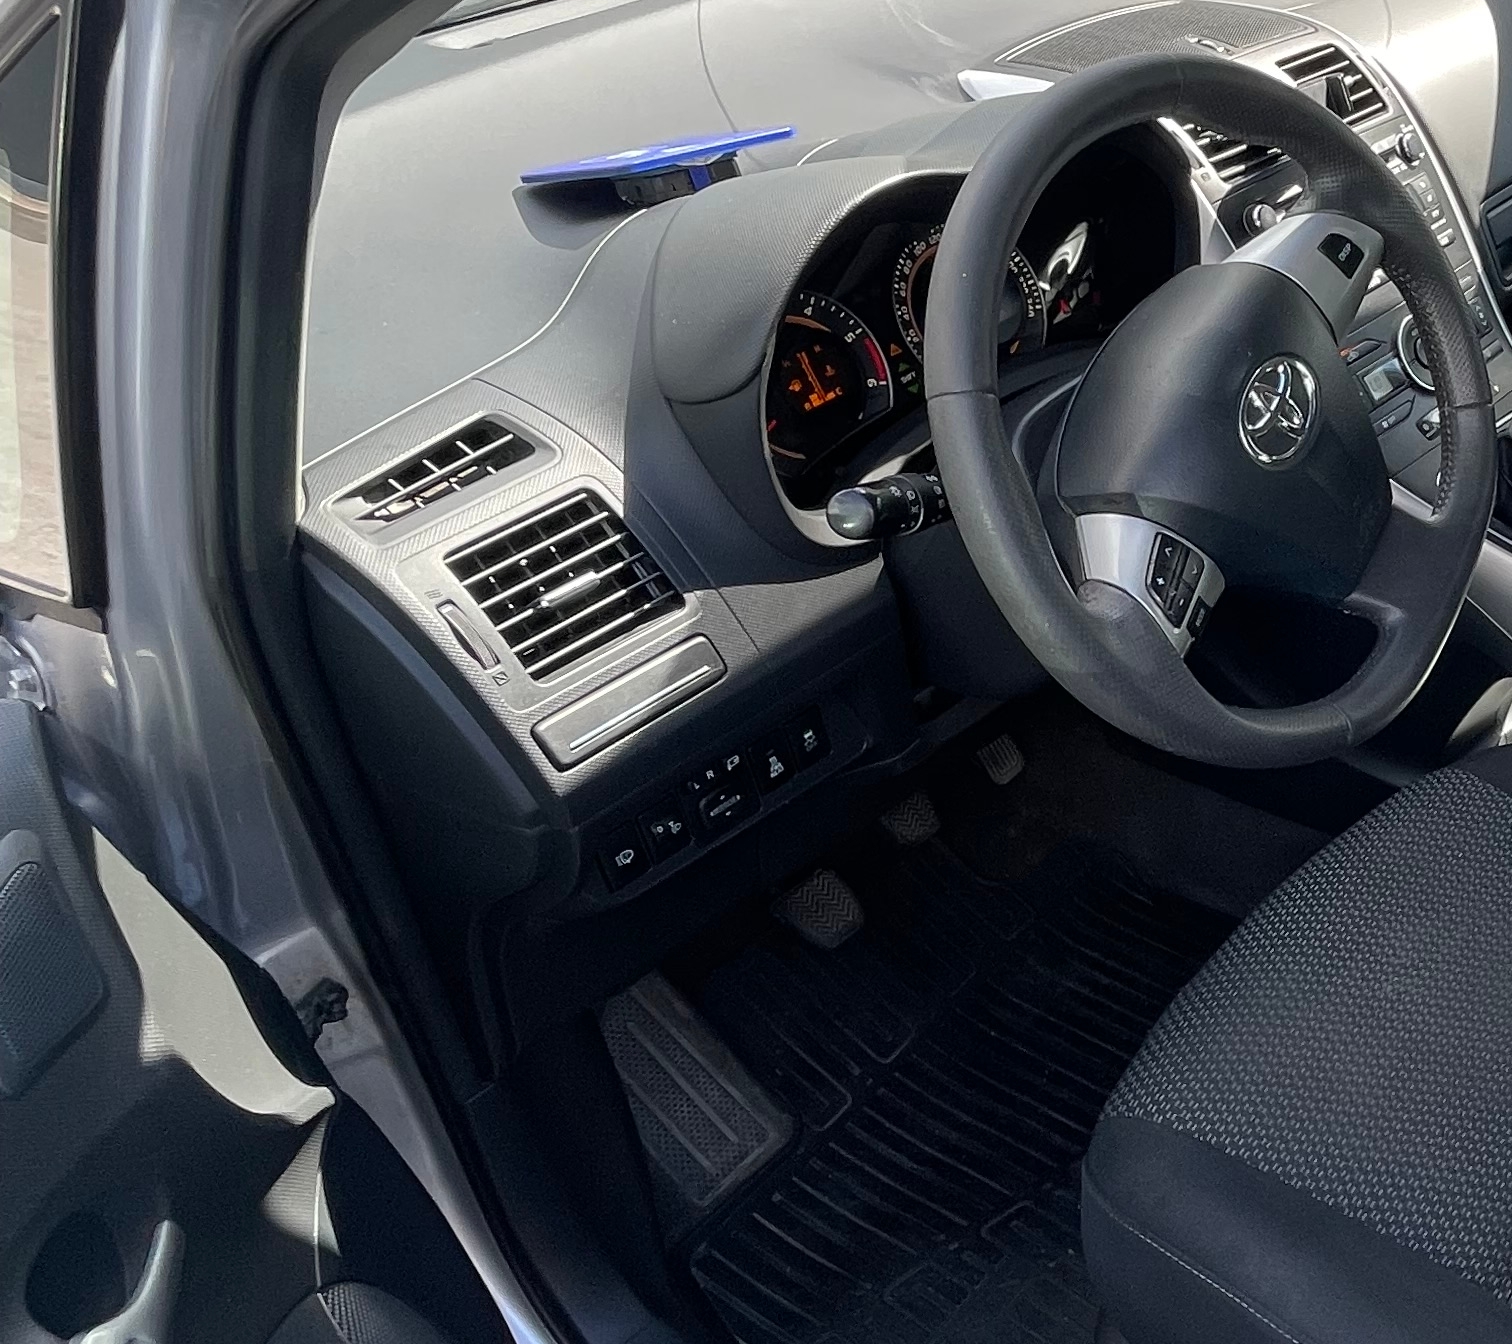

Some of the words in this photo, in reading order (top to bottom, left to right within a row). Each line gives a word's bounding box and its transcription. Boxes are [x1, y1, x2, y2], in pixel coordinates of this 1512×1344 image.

[903, 259, 913, 274] 80
[803, 306, 812, 316] 4
[901, 306, 910, 321] 40
[844, 332, 856, 343] 5
[866, 378, 878, 388] 6
[706, 770, 715, 780] R
